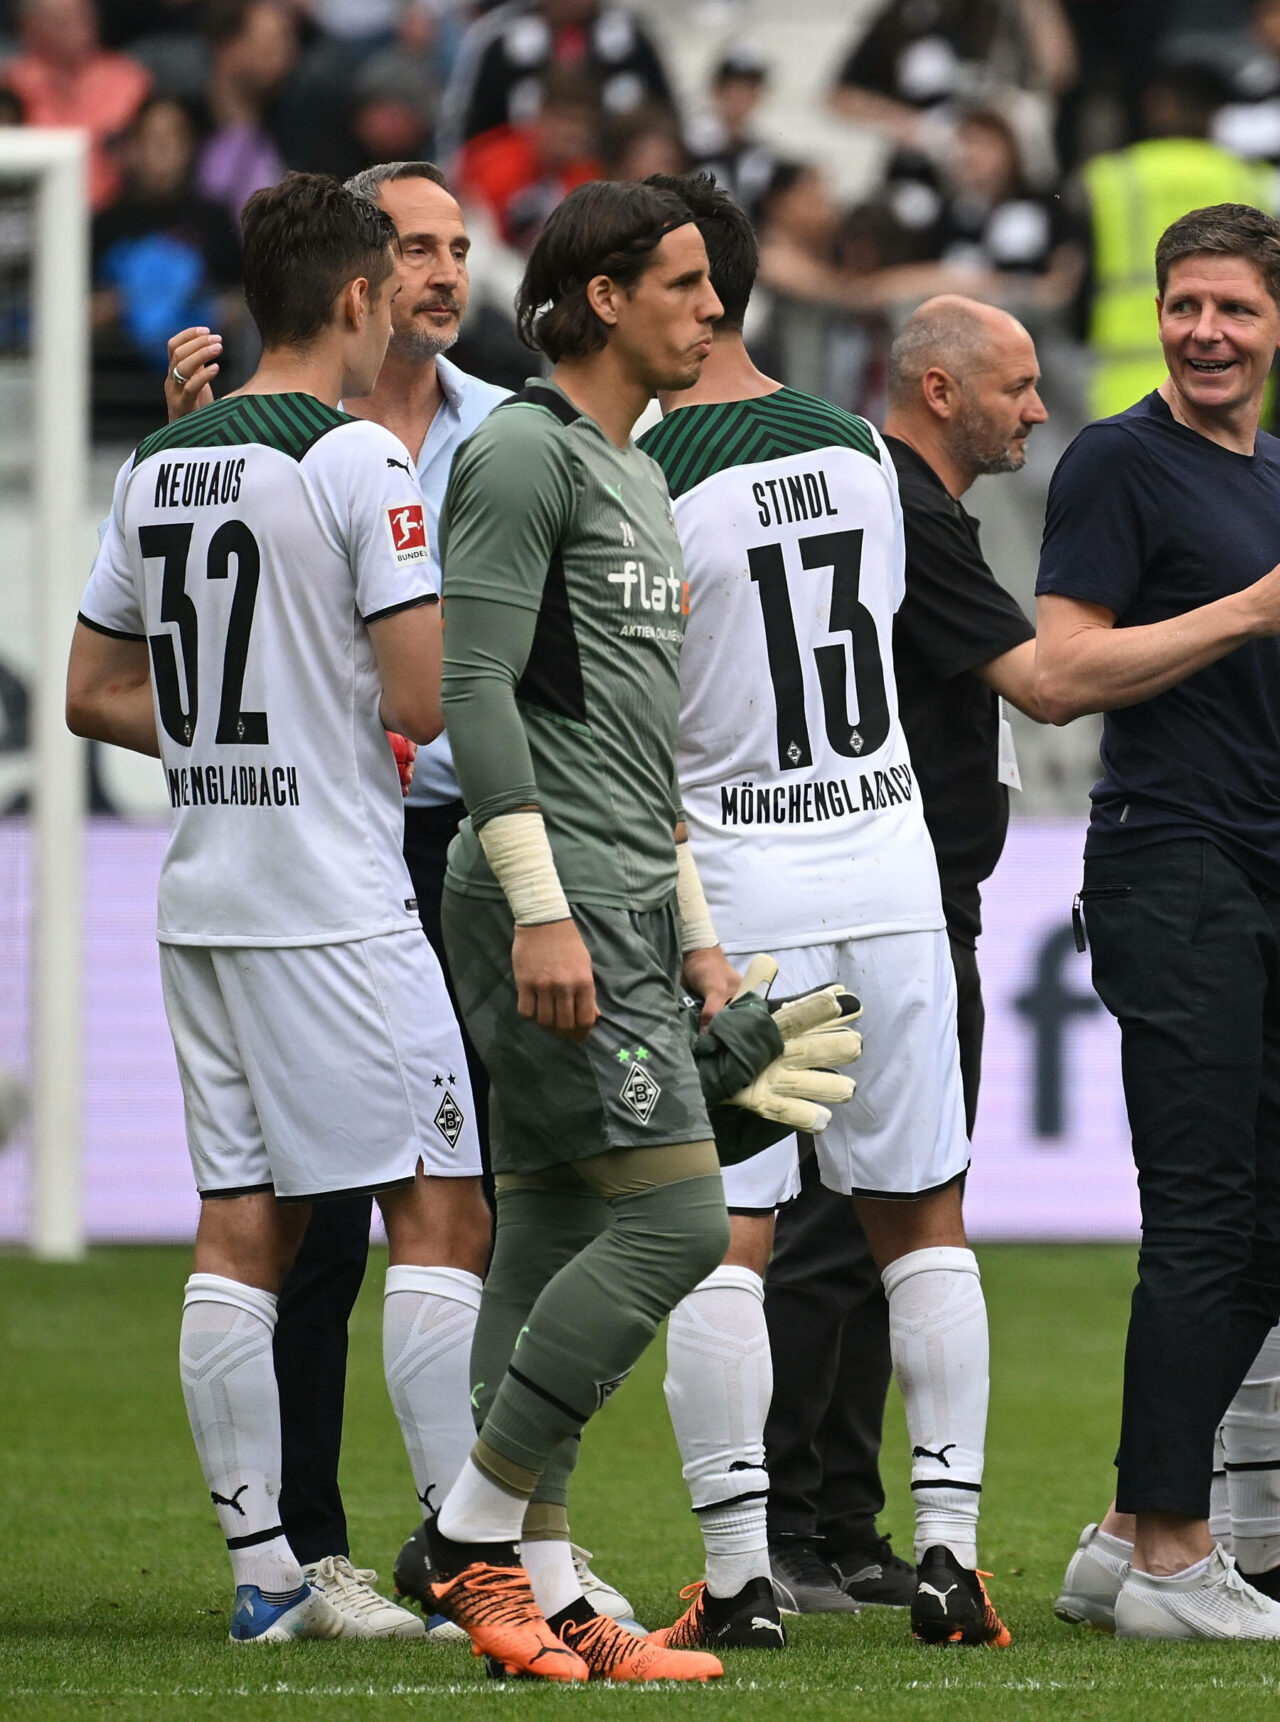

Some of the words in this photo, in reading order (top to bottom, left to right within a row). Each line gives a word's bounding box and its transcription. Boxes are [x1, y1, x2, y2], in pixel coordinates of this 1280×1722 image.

[154, 458, 245, 508] NEUHAUS
[752, 470, 838, 528] STINDL
[138, 519, 269, 747] 32
[746, 528, 890, 771] 13
